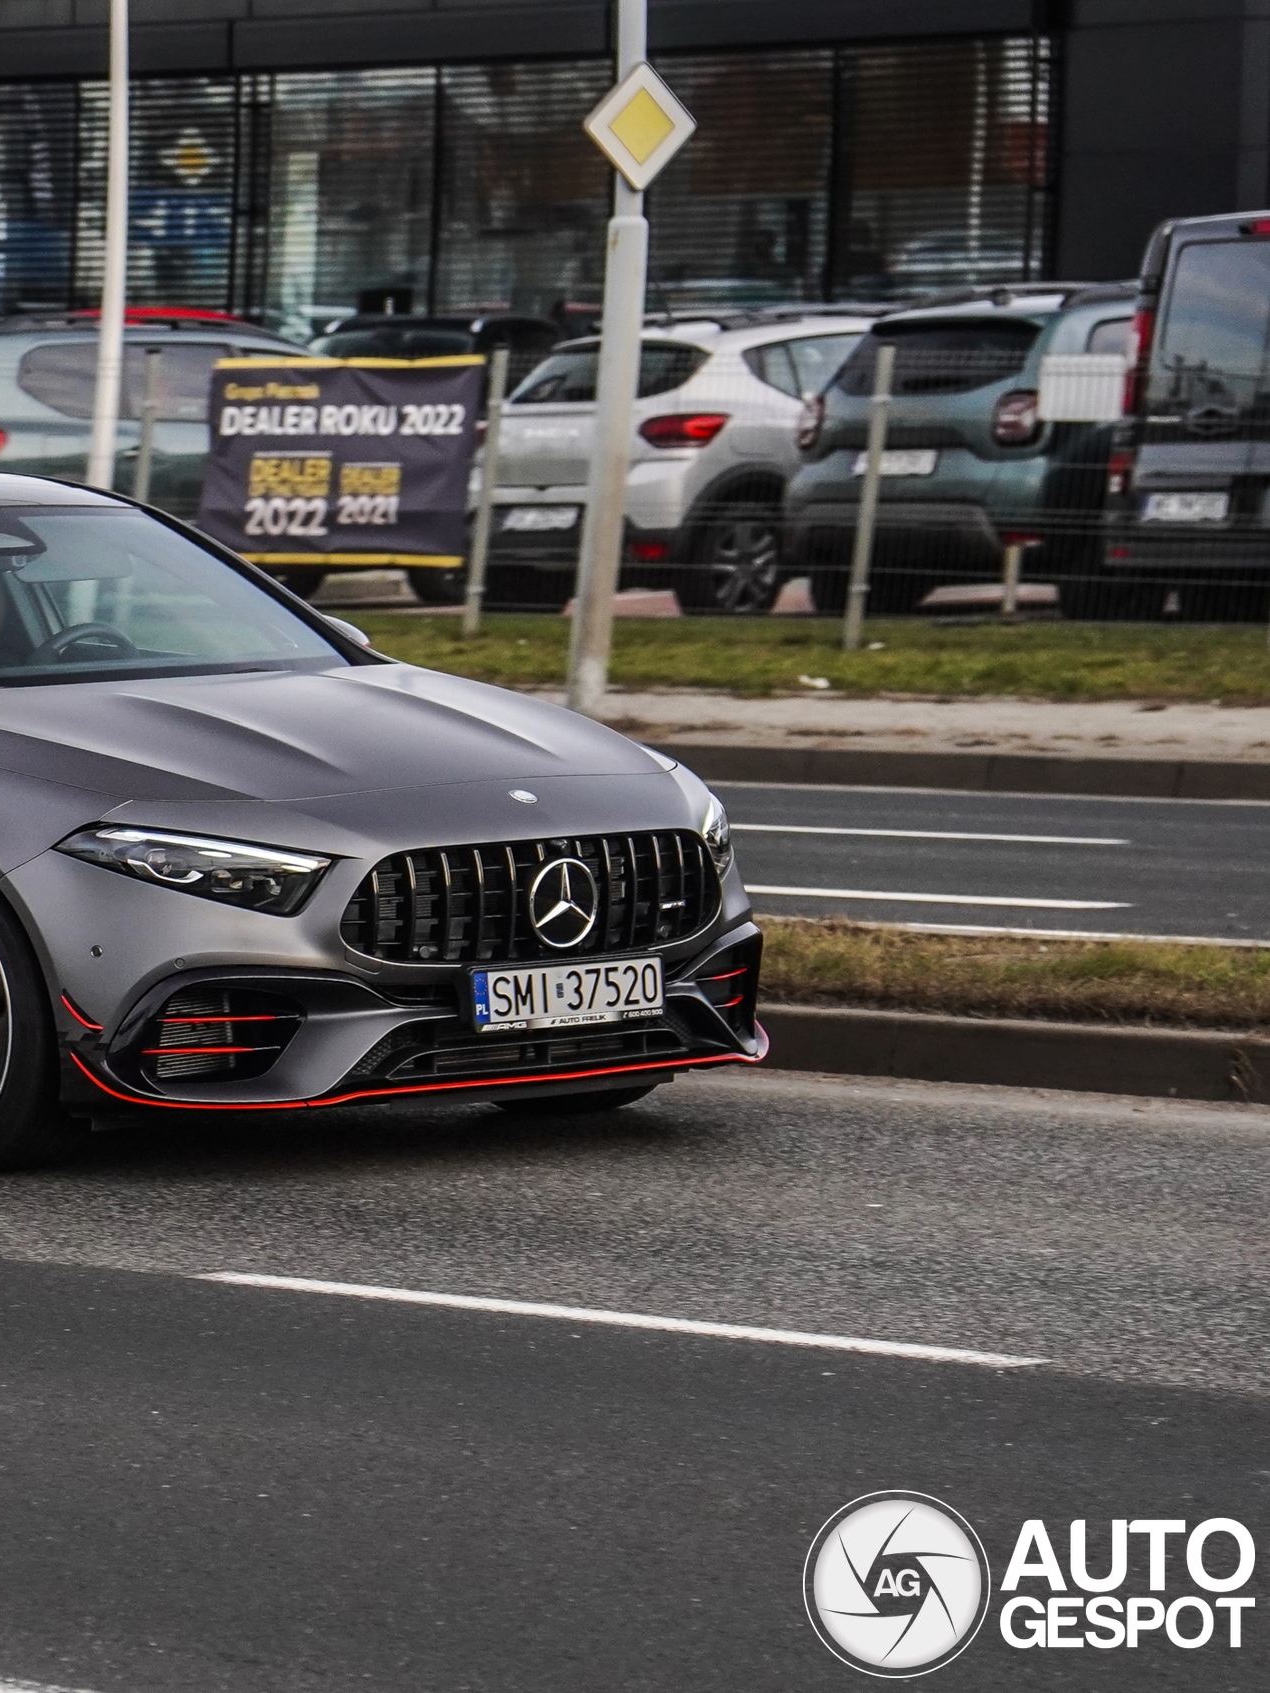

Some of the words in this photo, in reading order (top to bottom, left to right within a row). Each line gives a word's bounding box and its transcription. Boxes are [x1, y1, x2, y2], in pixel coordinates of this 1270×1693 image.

[220, 405, 318, 435] DEALER
[319, 404, 397, 435] ROKU
[400, 403, 466, 435] 2022
[244, 497, 329, 536] 2022
[336, 494, 401, 525] 2021
[493, 973, 550, 1018] SMI
[565, 963, 658, 1012] 37520
[476, 1003, 489, 1016] PL
[559, 1016, 580, 1024] AUTO
